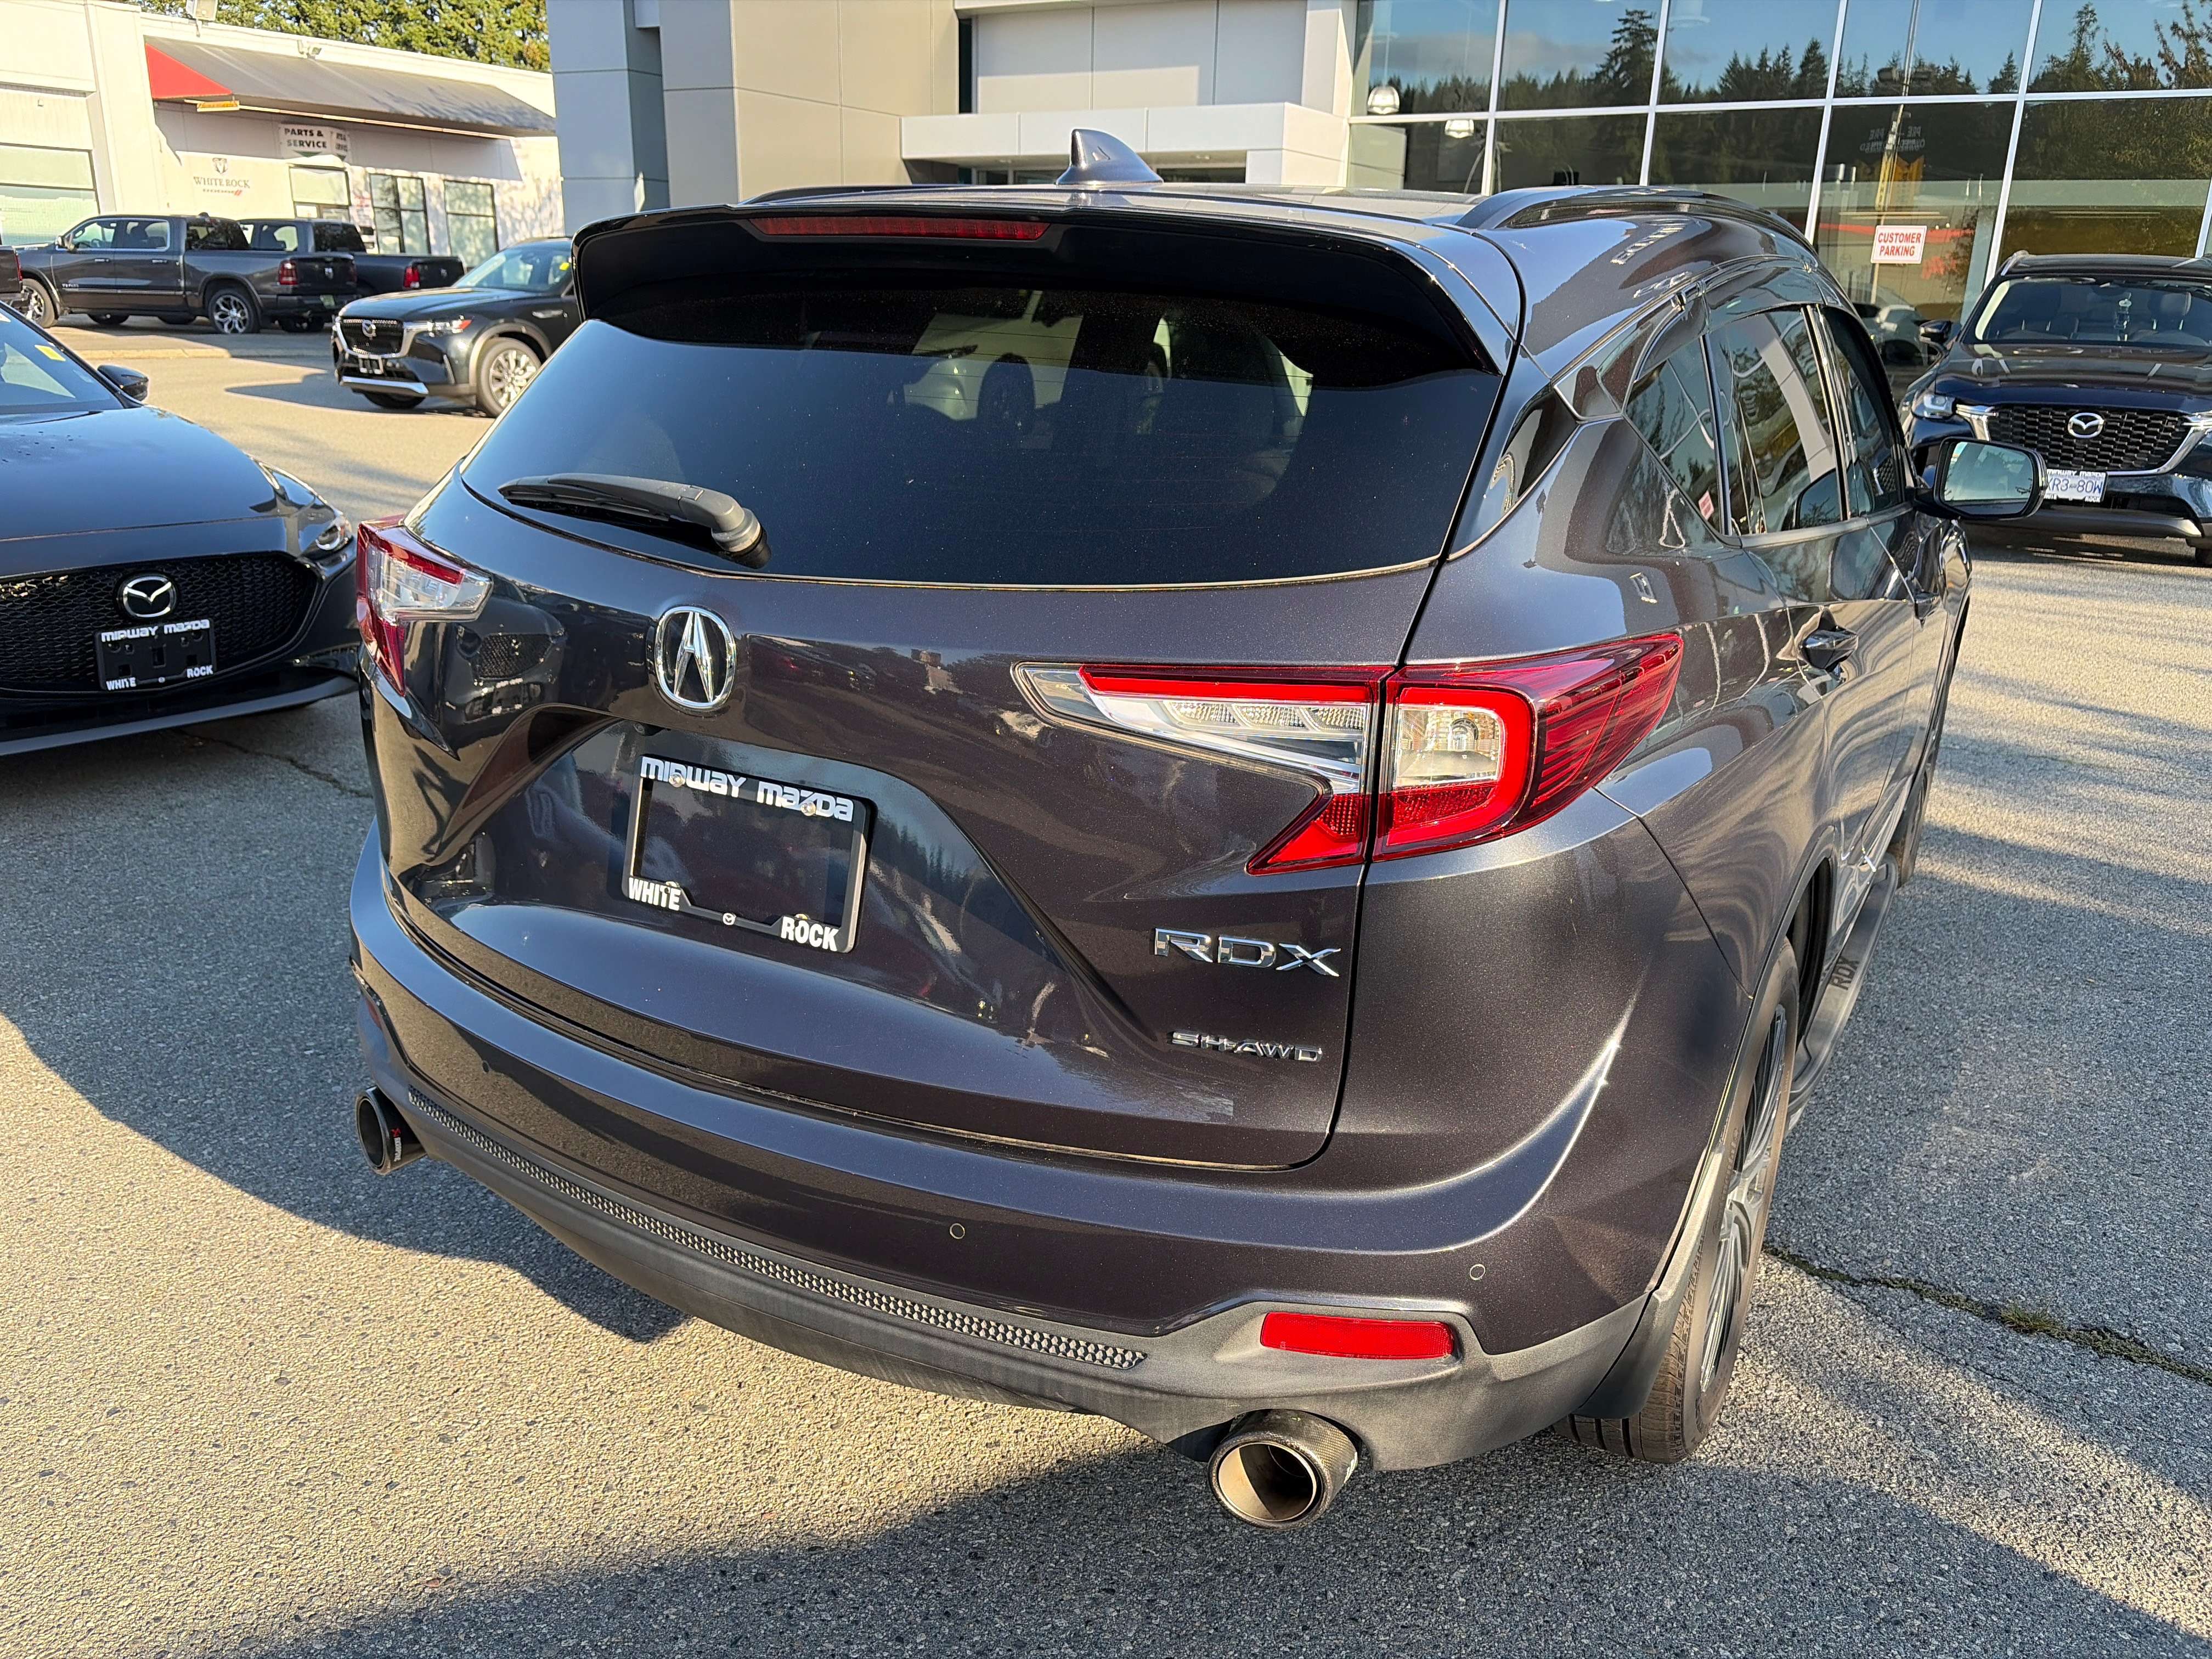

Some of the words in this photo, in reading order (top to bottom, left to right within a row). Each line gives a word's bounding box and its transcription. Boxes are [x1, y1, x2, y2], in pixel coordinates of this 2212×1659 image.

[284, 128, 314, 137] PARTS
[287, 139, 327, 148] SERVICE
[193, 176, 224, 187] WHITE
[225, 179, 251, 189] ROCK
[1878, 232, 1922, 243] CUSTOMER
[1879, 245, 1915, 256] PARKING
[106, 677, 137, 691] WHITE
[187, 664, 213, 678] ROCK
[628, 877, 682, 911] WHITE
[781, 916, 839, 952] ROCK
[1154, 927, 1341, 978] RDX
[1831, 956, 1860, 991] RDX
